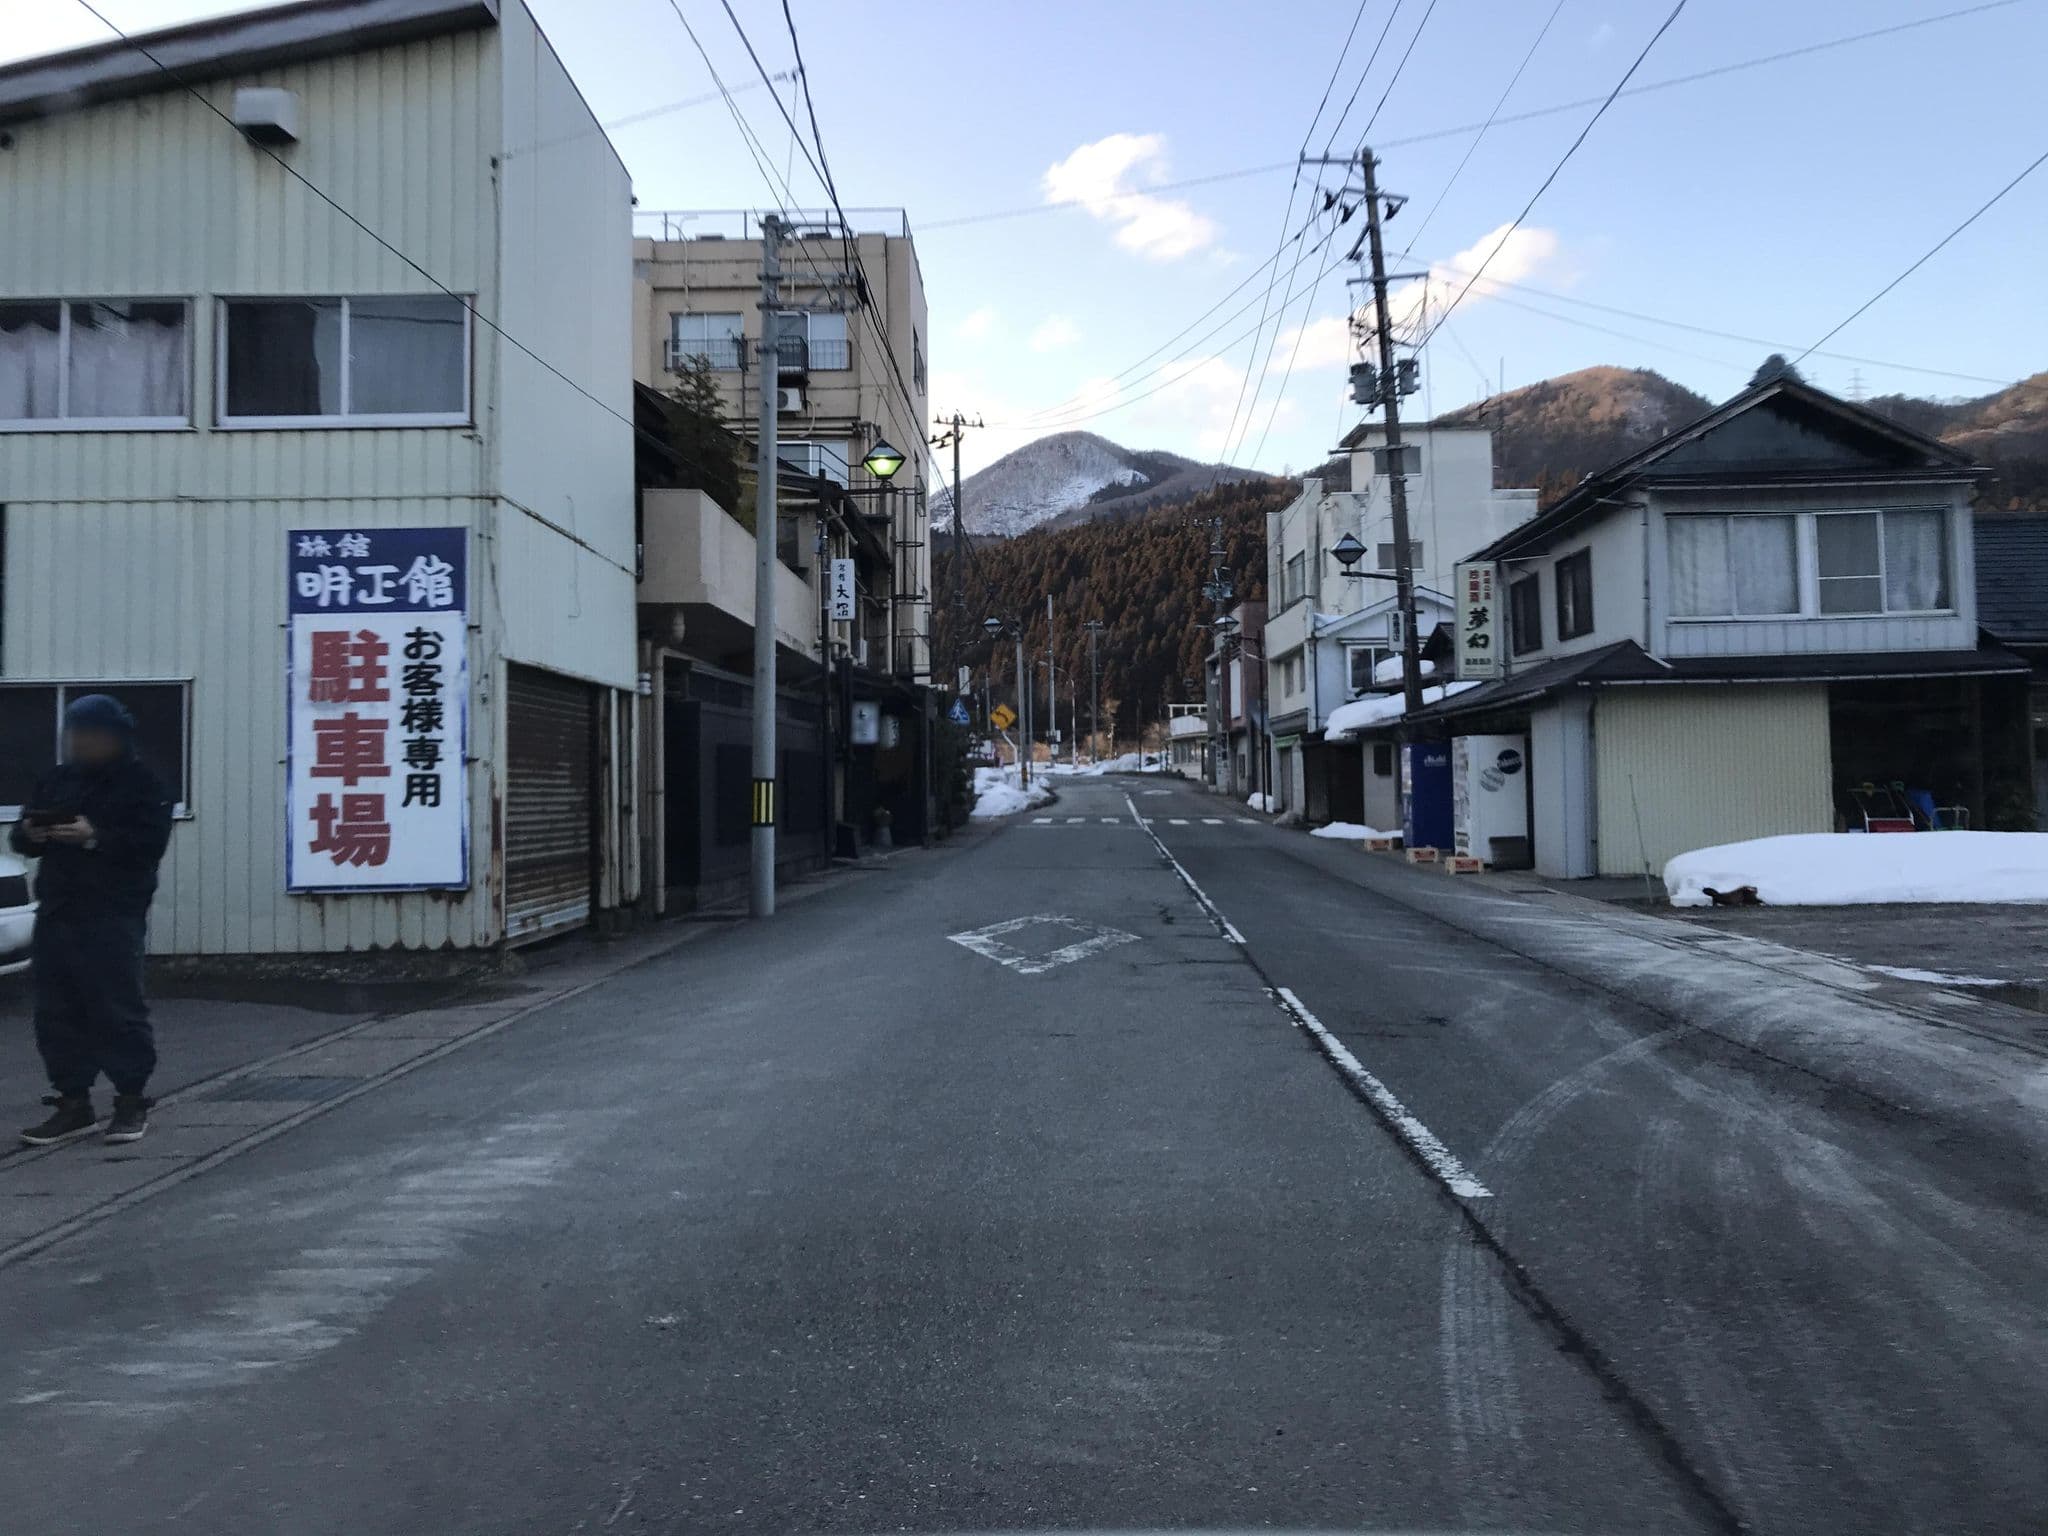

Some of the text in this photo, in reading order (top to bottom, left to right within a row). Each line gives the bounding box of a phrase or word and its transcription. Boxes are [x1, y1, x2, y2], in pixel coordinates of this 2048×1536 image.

[296, 554, 455, 608] 明正館
[308, 629, 392, 867] 駐車場
[401, 626, 445, 808] お客様専用
